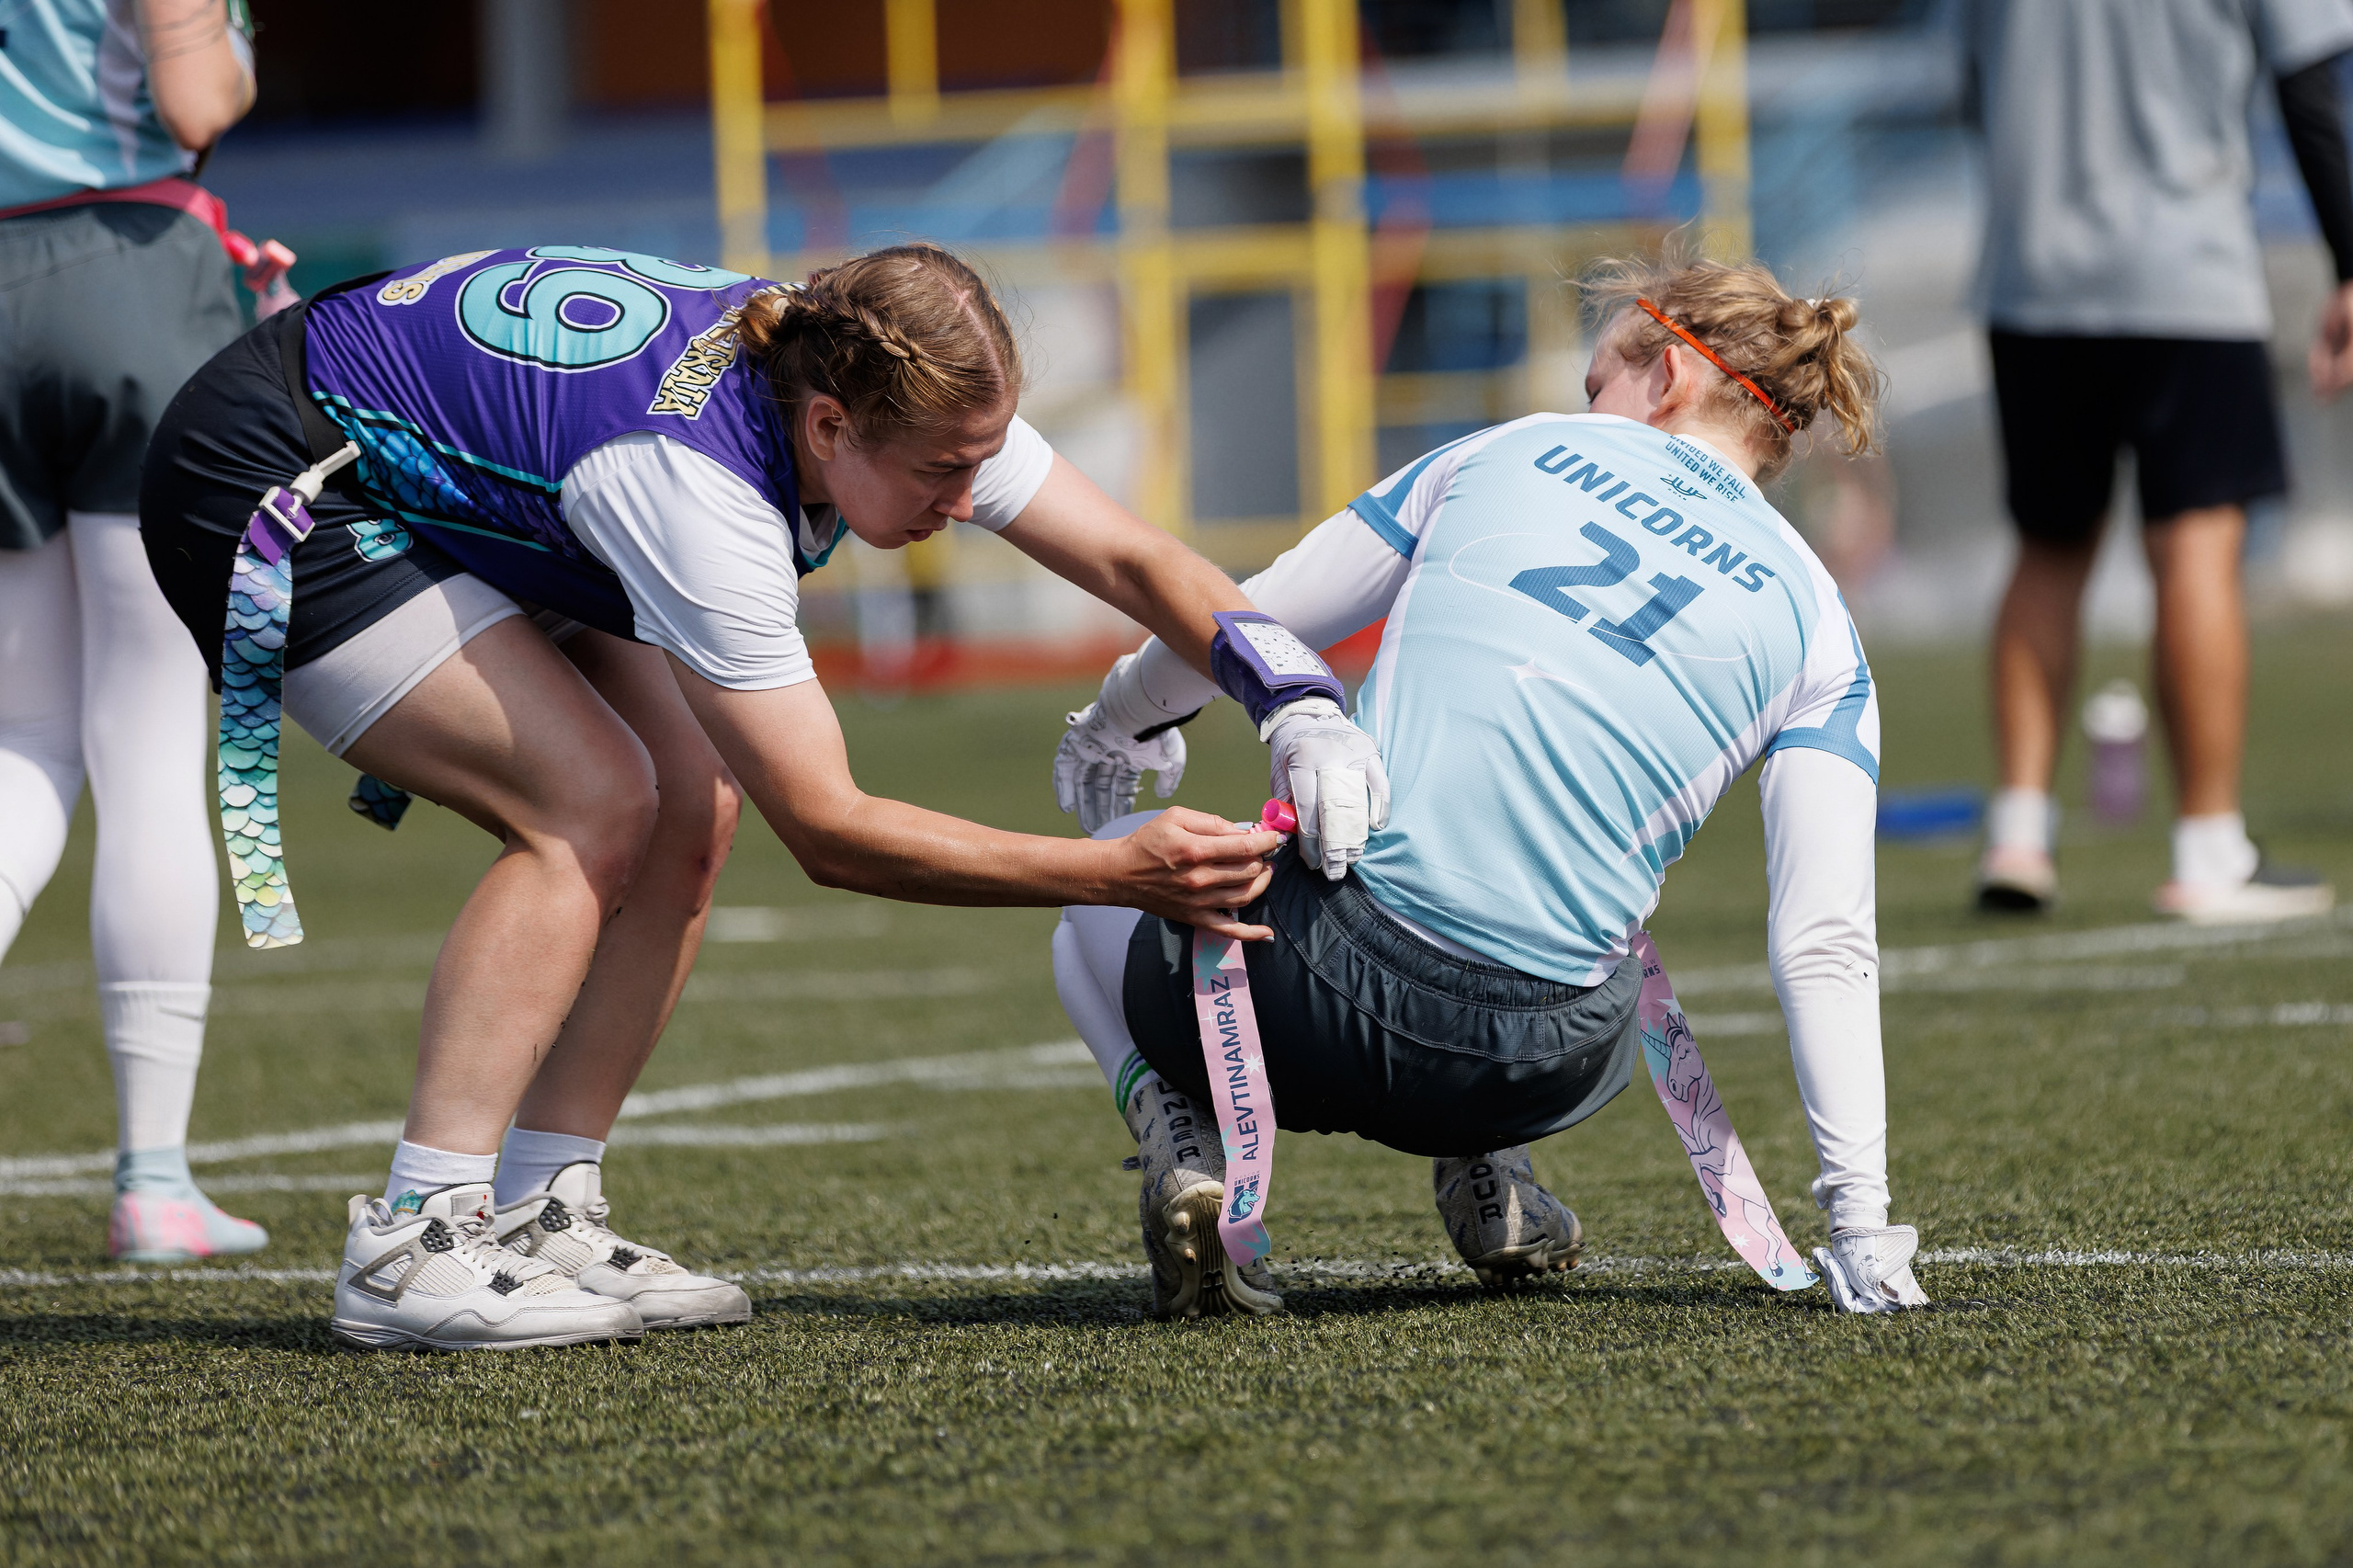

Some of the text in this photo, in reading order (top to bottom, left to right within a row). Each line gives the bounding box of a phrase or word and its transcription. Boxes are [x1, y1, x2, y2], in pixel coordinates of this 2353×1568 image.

[1533, 444, 1776, 593] UNICORNS
[1665, 441, 1739, 504] UNITED WE RISE
[1708, 460, 1725, 477] WE
[1723, 473, 1746, 499] FALL,
[1507, 520, 1706, 668] 21
[1210, 975, 1259, 1161] ALEVTINAMRAZ
